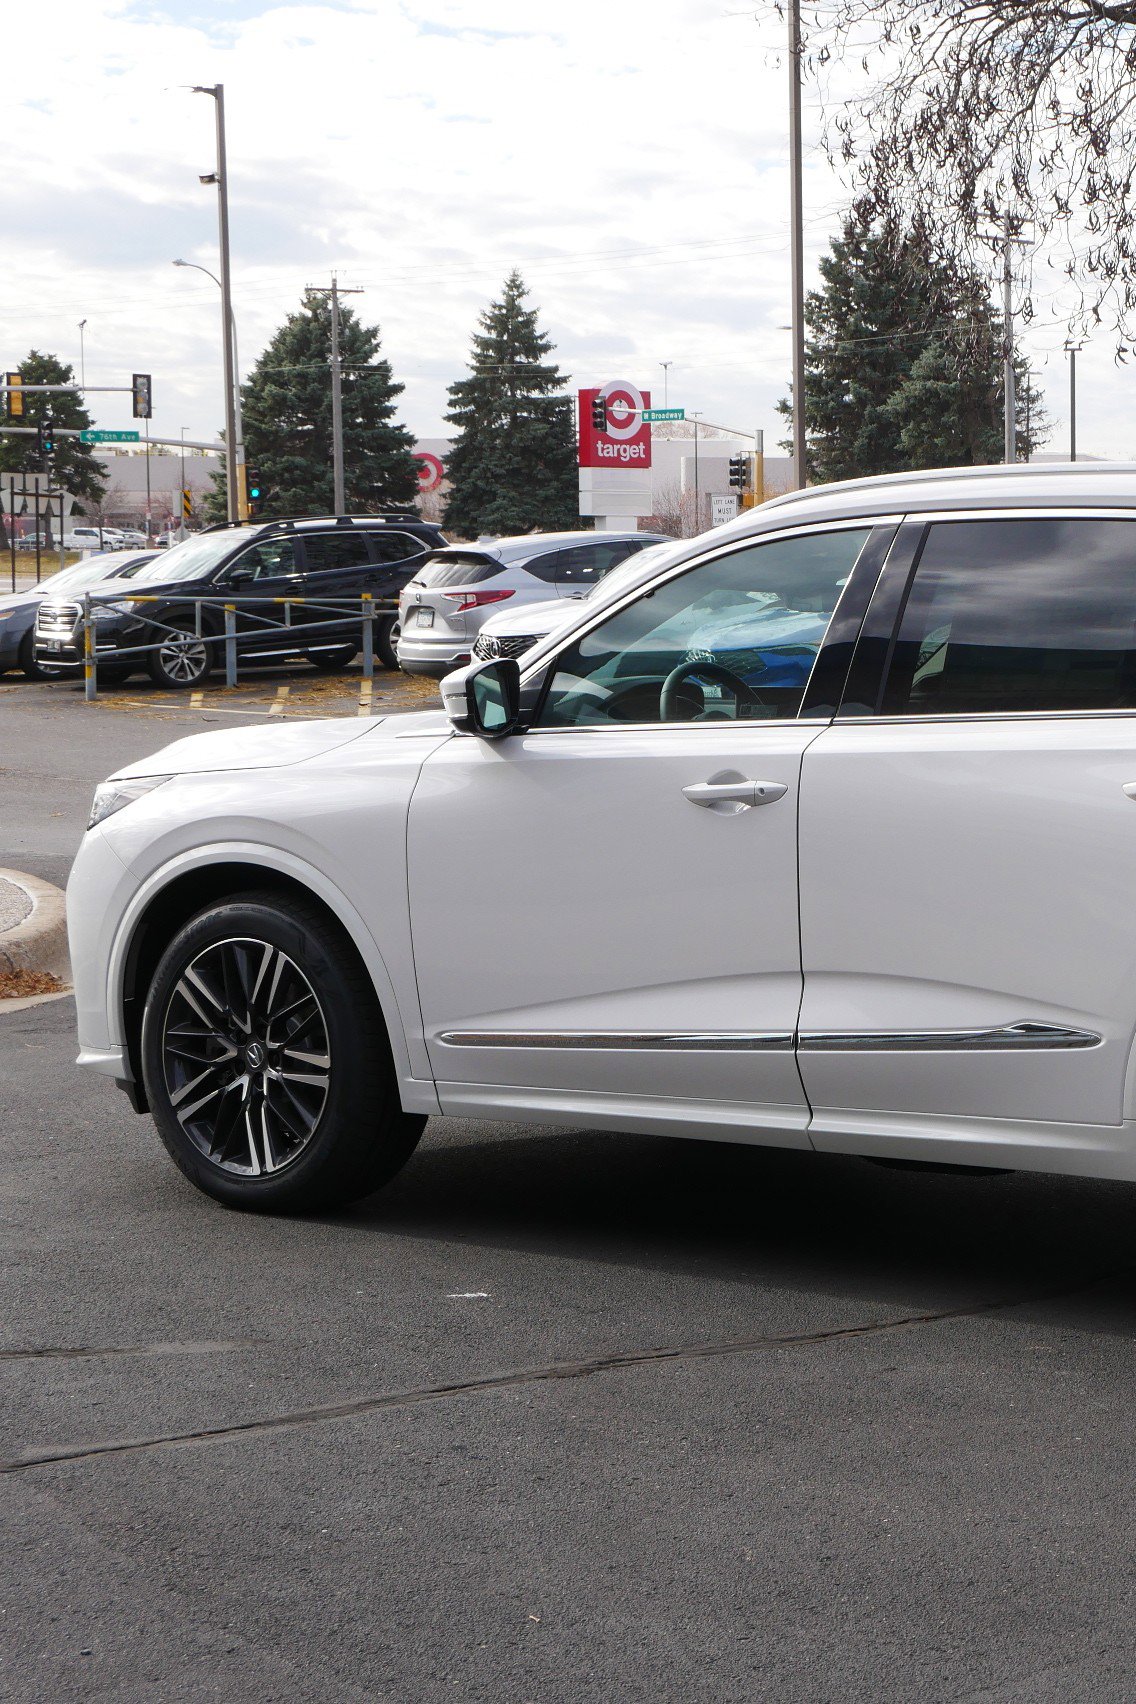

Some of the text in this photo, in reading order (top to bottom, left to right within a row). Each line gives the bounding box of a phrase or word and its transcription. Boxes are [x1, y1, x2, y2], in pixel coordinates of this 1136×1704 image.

[651, 411, 682, 420] Broadway
[596, 441, 646, 461] target
[717, 507, 732, 515] MUST
